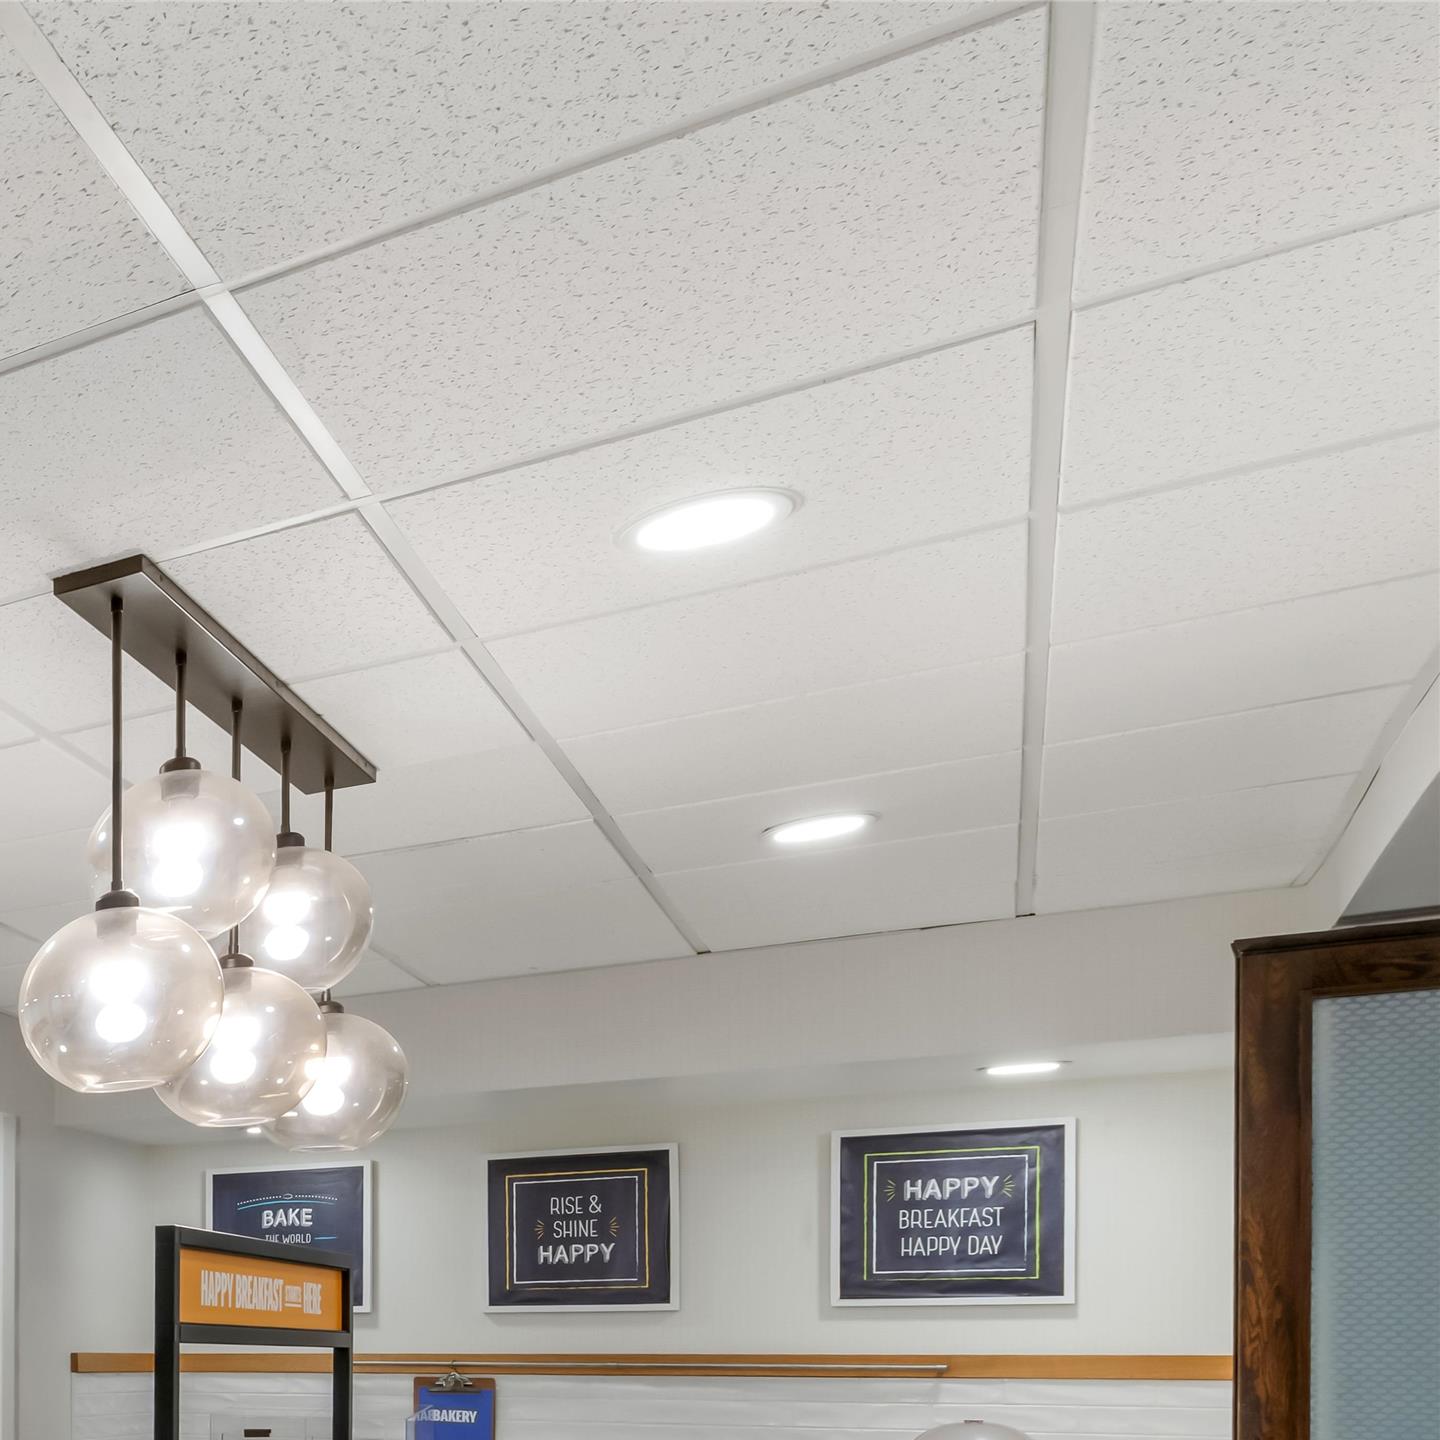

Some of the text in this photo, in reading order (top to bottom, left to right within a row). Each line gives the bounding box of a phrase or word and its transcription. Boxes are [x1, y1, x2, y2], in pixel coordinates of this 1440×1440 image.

[903, 1176, 1000, 1201] HAPPY
[550, 1195, 601, 1215] RISE &
[262, 1208, 313, 1229] BAKE
[553, 1219, 598, 1238] SHINE
[899, 1207, 1005, 1229] BREAKFAST
[282, 1233, 311, 1244] WORLD
[901, 1235, 1003, 1256] HAPPY DAY
[538, 1242, 615, 1265] HAPPY
[200, 1270, 234, 1308] HAPPY
[235, 1274, 283, 1312] BREAKFAST
[433, 1409, 478, 1423] BAKERY
